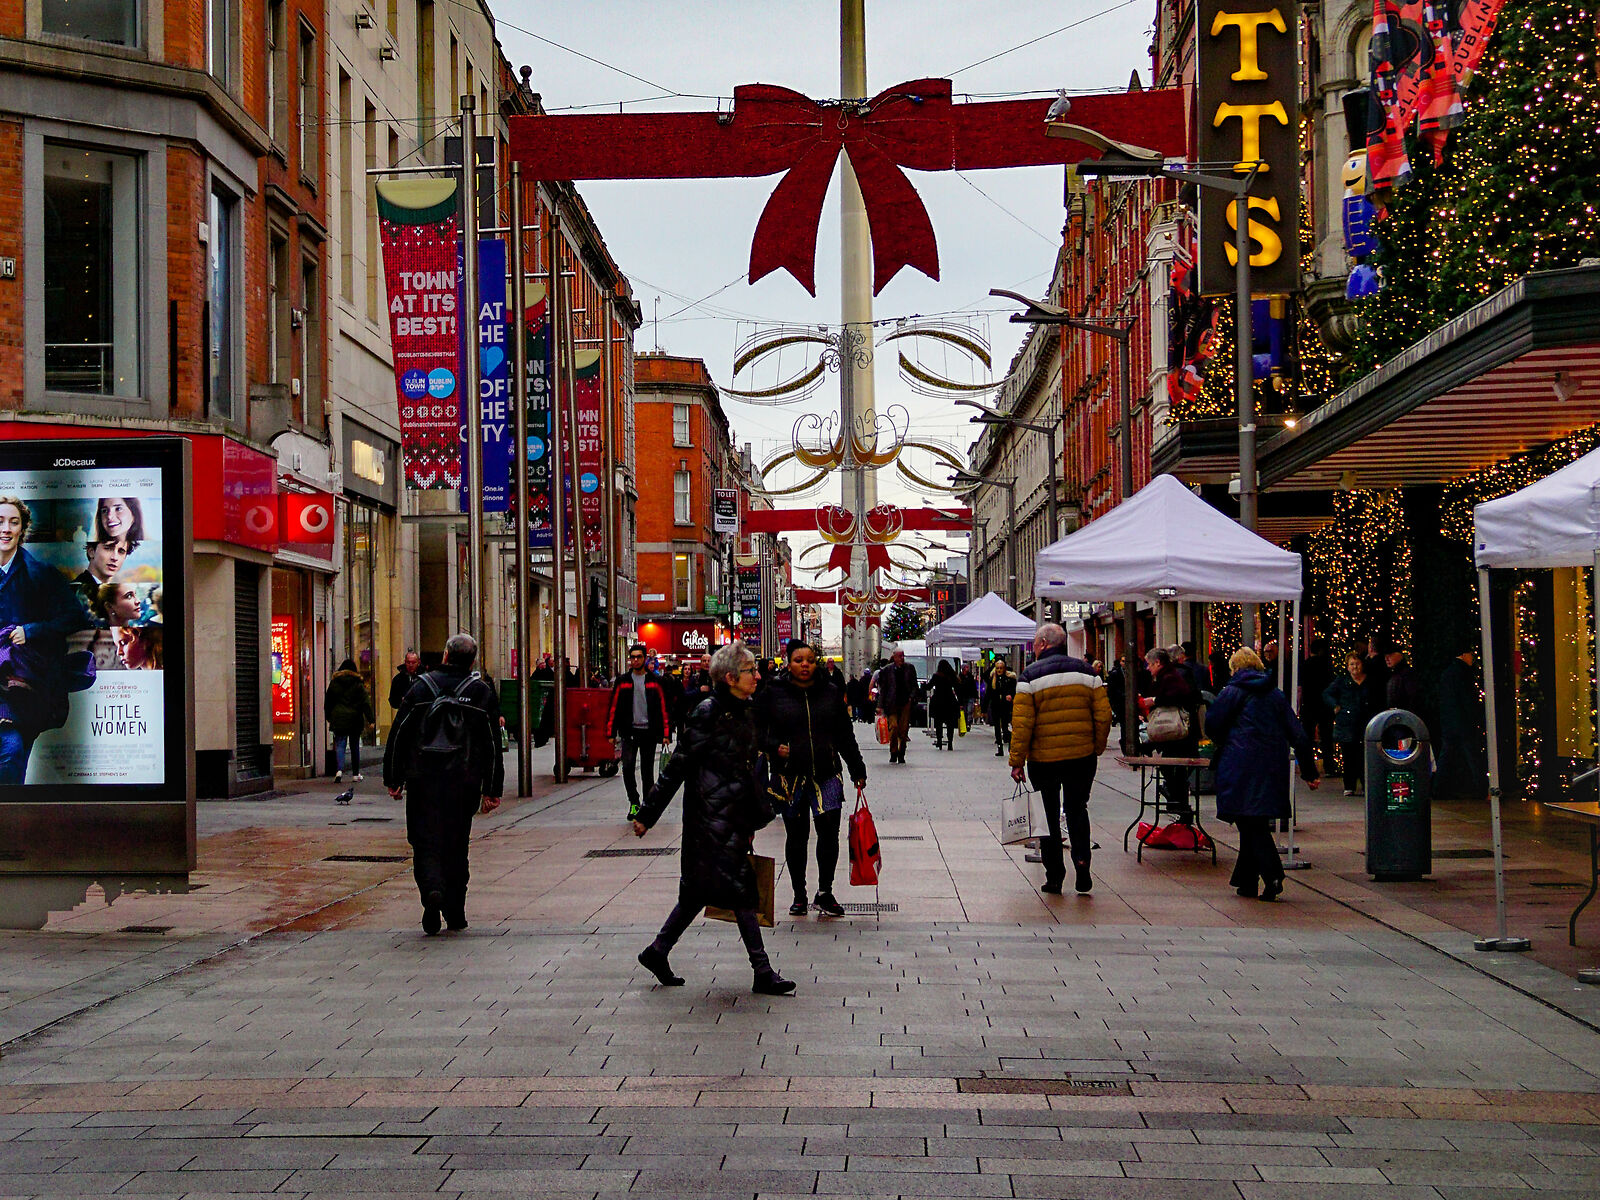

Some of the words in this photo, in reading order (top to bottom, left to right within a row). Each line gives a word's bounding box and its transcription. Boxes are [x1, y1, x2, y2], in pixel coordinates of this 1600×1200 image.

[1453, 1, 1492, 74] DUBLIN
[399, 270, 455, 291] TOWN
[390, 294, 417, 313] AT
[423, 293, 456, 312] ITS
[479, 302, 503, 320] AT
[396, 316, 456, 336] BEST!
[479, 325, 504, 343] HE
[480, 379, 505, 398] OF
[480, 402, 505, 420] HE
[459, 424, 505, 443] CTY
[53, 458, 96, 467] JCDecaux
[95, 703, 142, 721] LITTLE
[91, 721, 147, 737] WOMEN
